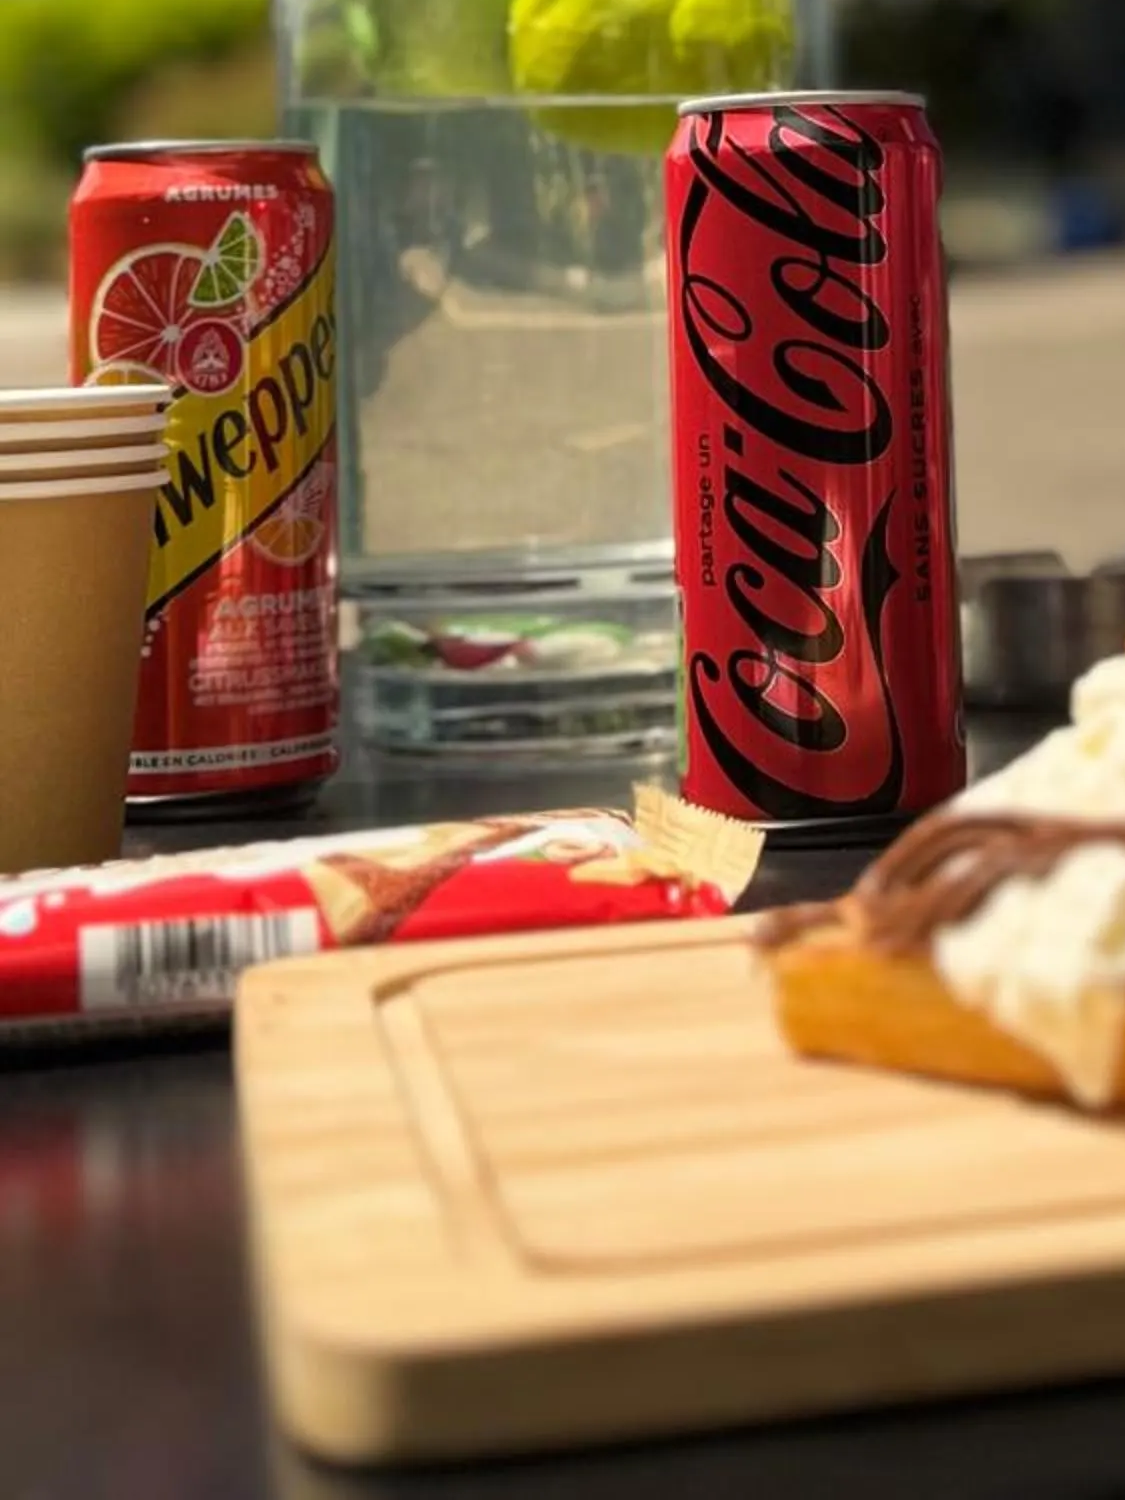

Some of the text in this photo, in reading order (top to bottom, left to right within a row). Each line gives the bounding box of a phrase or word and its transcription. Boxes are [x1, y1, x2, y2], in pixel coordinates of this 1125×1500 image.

[165, 184, 279, 203] AGRUMES
[153, 312, 336, 549] weppe
[679, 104, 903, 818] Coca-Cola
[910, 368, 927, 501] SUCRES
[698, 433, 717, 586] partage un
[914, 511, 931, 603] SANS
